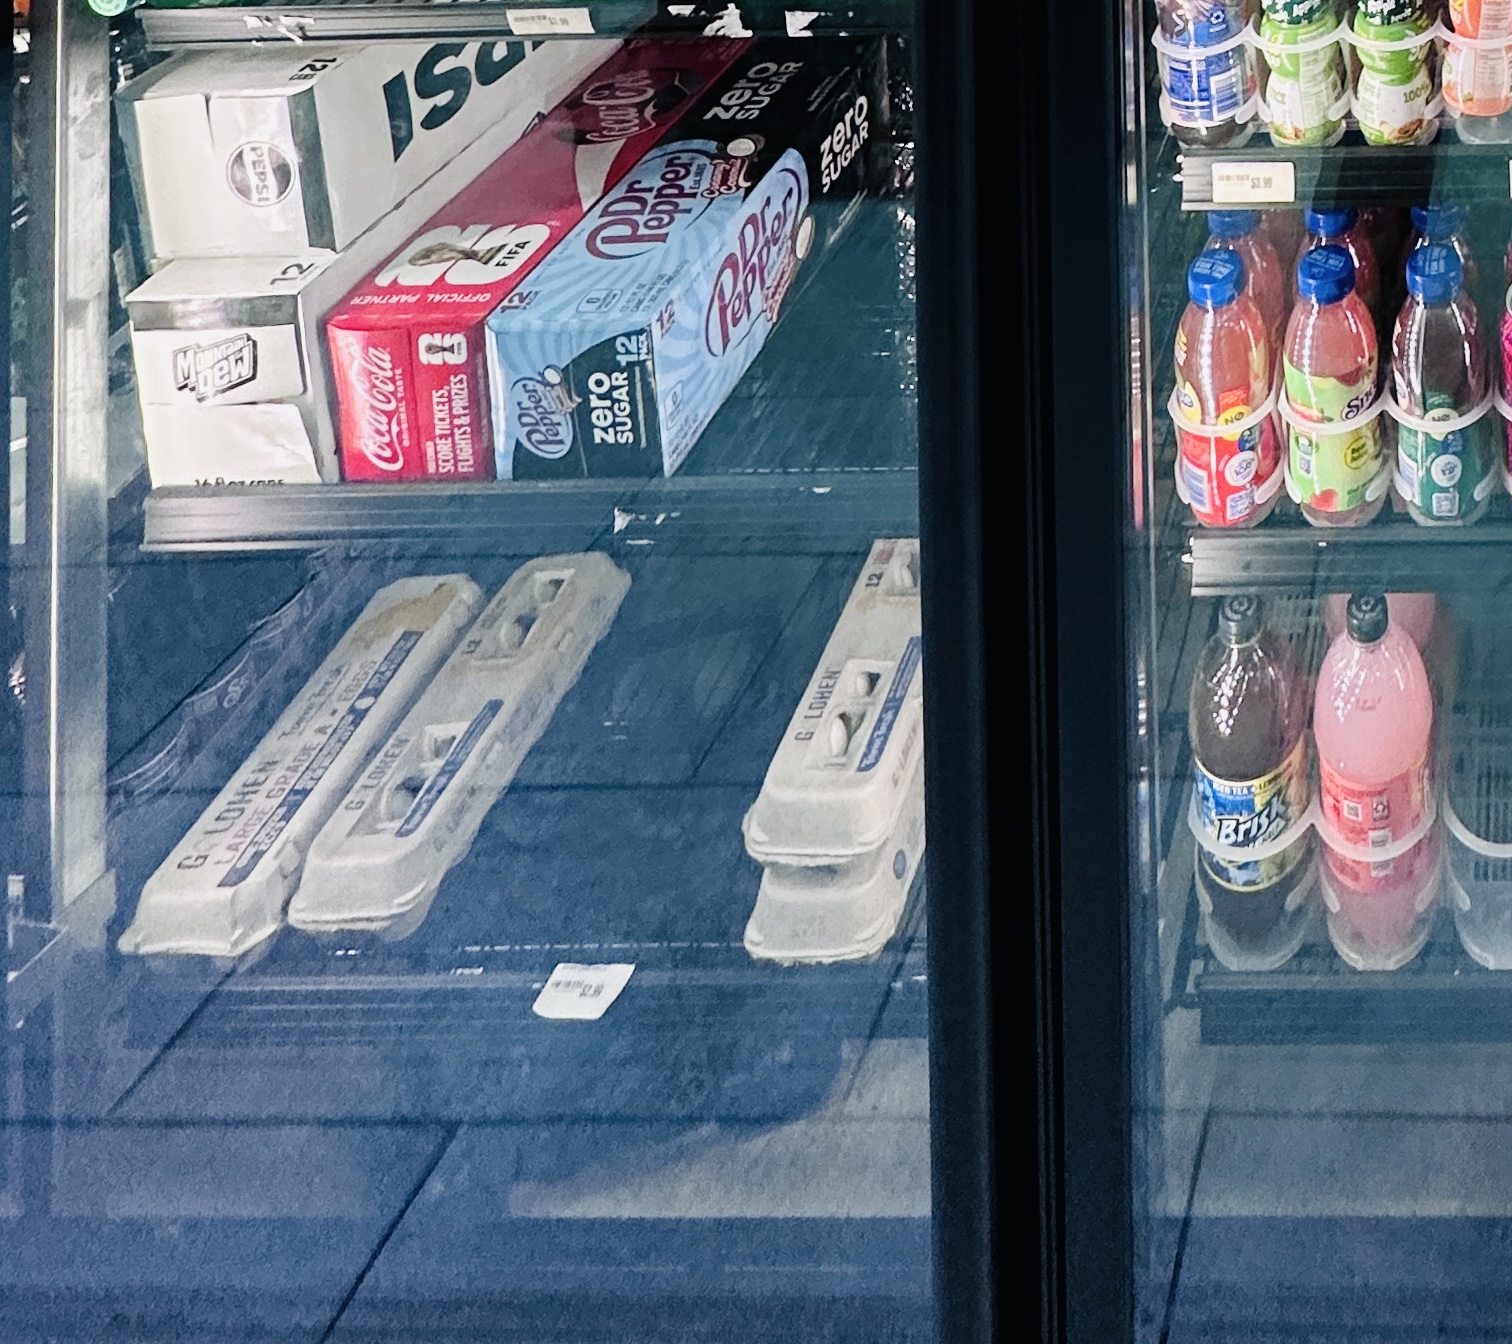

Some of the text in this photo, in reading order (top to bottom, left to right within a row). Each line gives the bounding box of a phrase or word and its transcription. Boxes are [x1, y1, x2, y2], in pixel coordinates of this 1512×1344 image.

[703, 62, 780, 120] zero
[735, 61, 804, 120] SUGAR
[819, 95, 868, 172] zero
[821, 119, 869, 194] SUGAR
[247, 144, 271, 204] PEPSI
[591, 155, 699, 246] Pepper
[599, 179, 655, 220] Dr
[495, 239, 532, 268] FIFA
[737, 195, 771, 264] Dr
[350, 292, 492, 304] OFFICIAL PARTNER
[500, 291, 530, 313] 12
[717, 186, 795, 356] Pepper
[615, 335, 639, 367] 12
[432, 385, 454, 474] SCORE TICKETS,
[450, 374, 474, 473] FLIGHTS & PRIZES
[520, 382, 565, 446] Pepper
[588, 372, 616, 445] zero
[611, 371, 634, 444] SUGAR
[865, 570, 884, 589] 12
[214, 808, 270, 866] LARGE
[265, 741, 321, 800] GRADE
